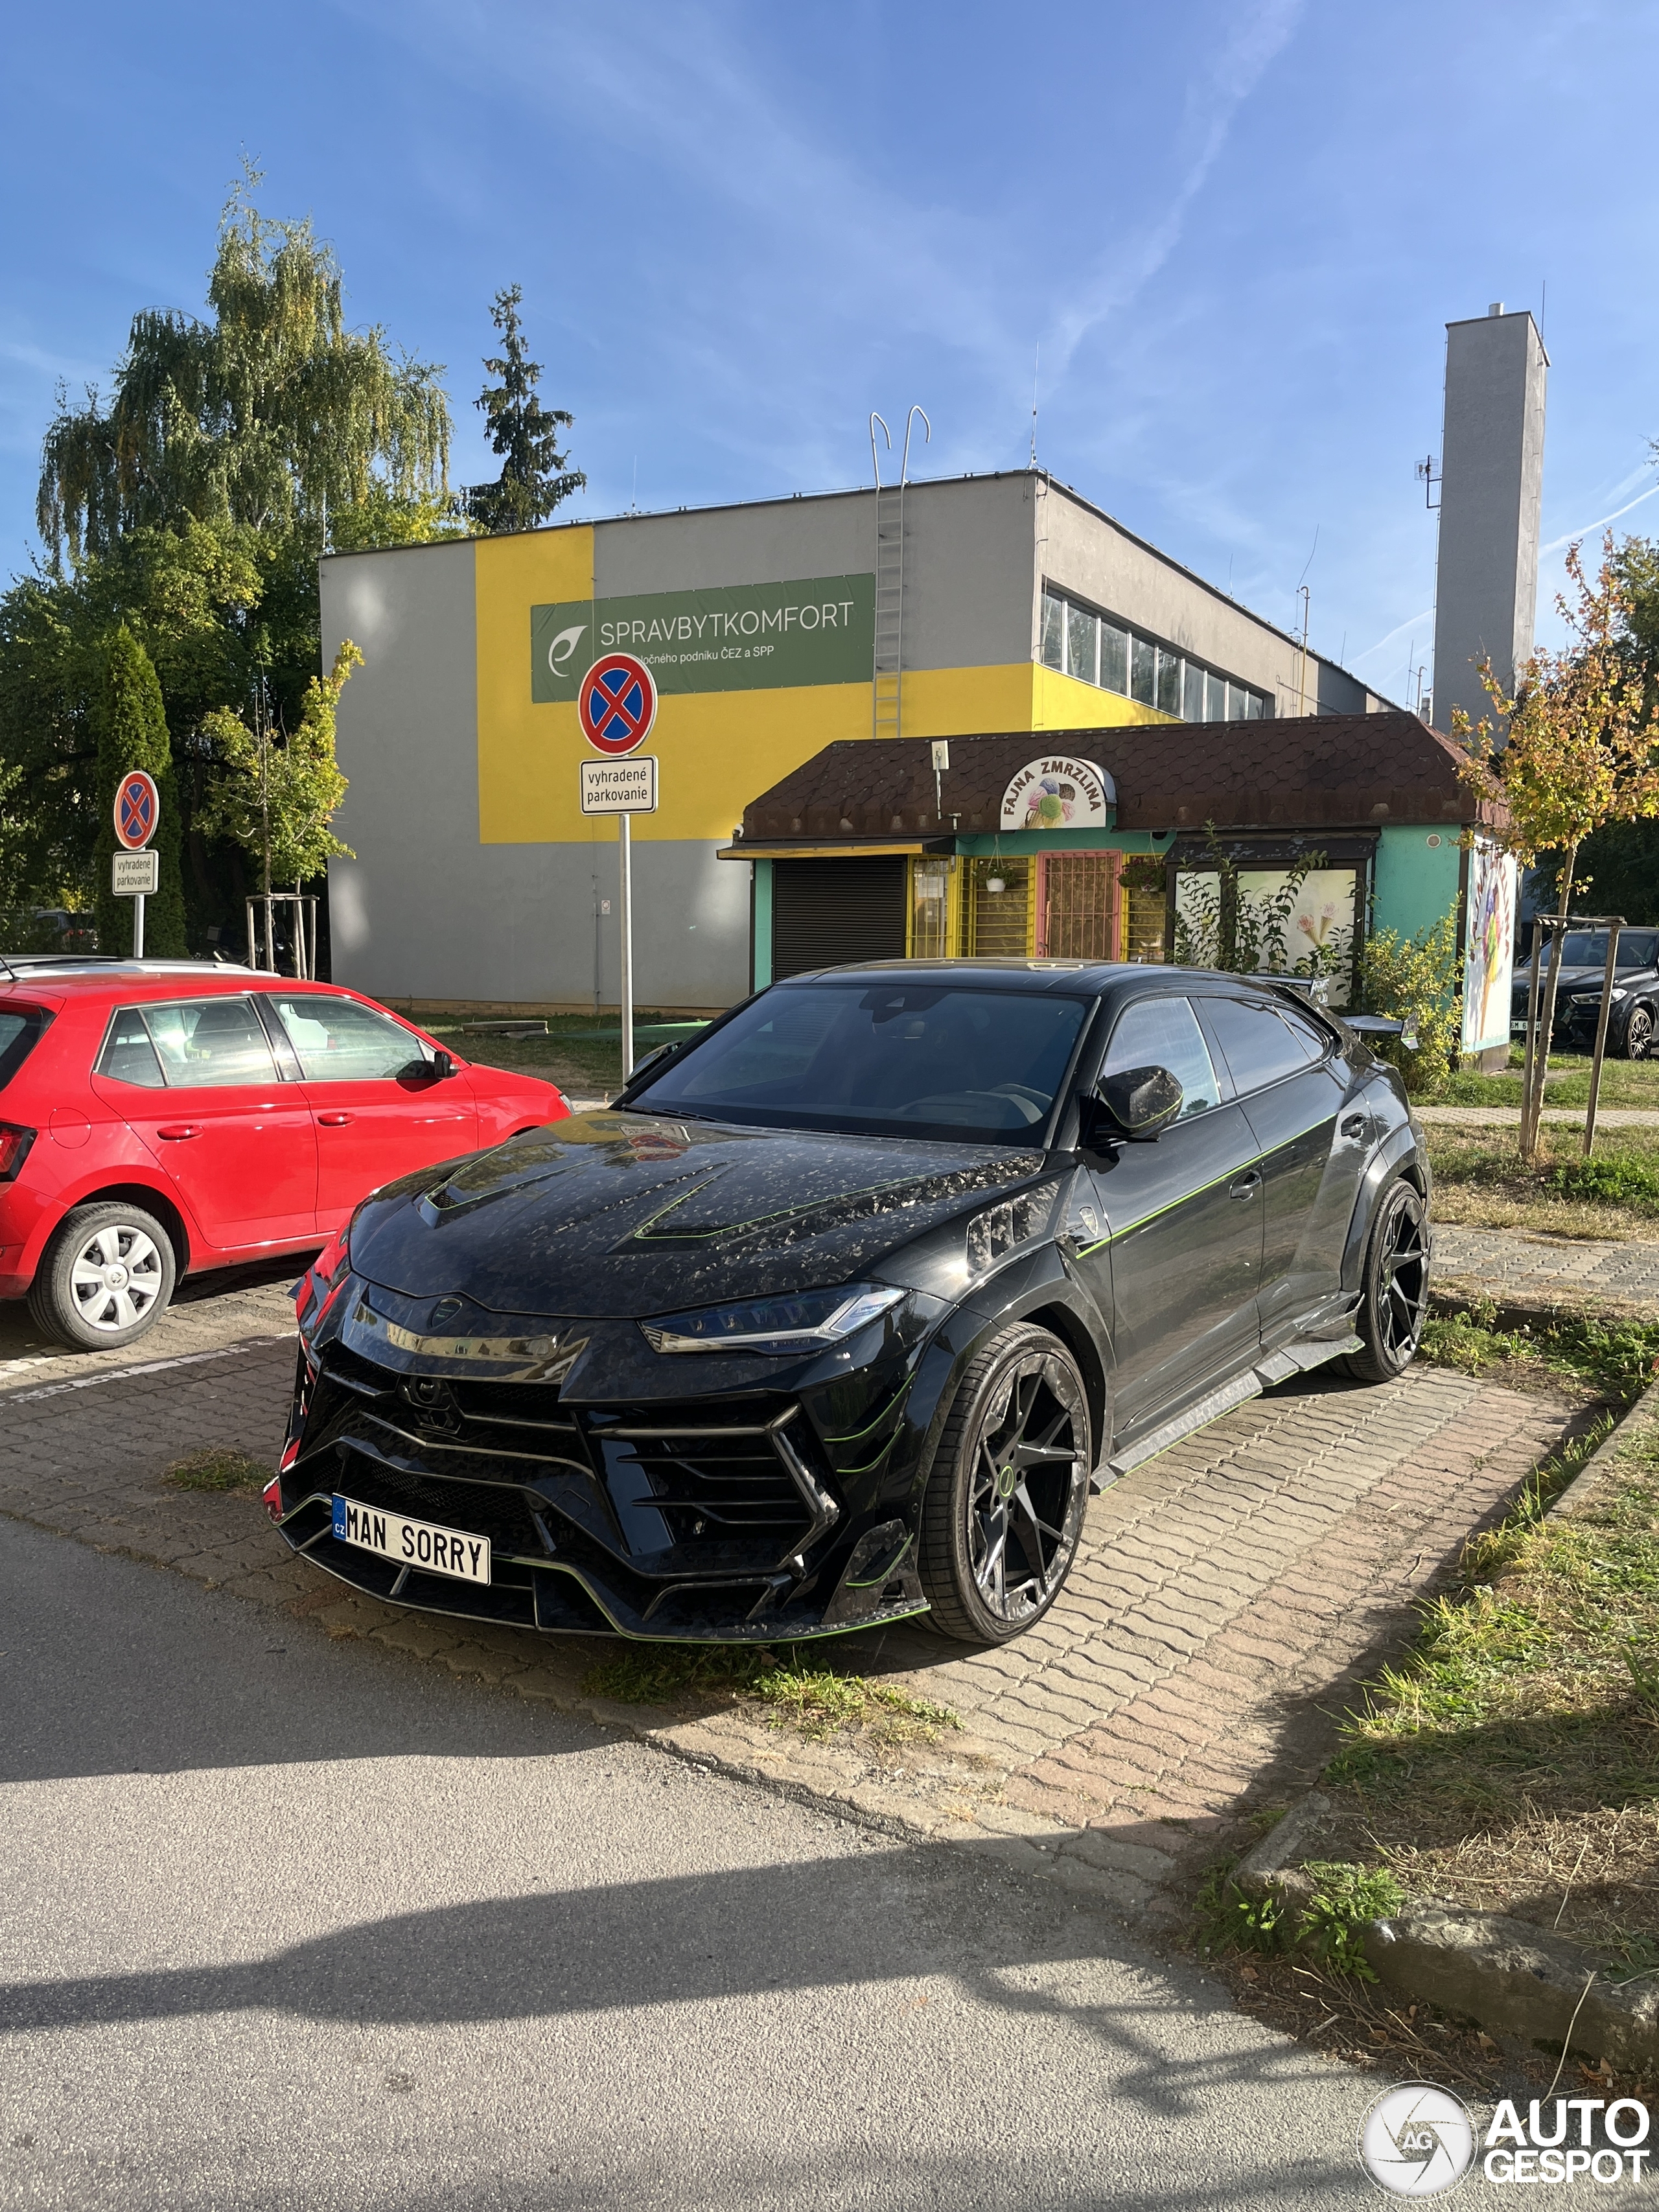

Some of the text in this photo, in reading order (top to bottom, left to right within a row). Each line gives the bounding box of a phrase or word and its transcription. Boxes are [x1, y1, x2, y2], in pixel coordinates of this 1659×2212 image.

[600, 601, 854, 646] SPRAVBYTKOMFORT
[641, 646, 774, 665] ločného podniku ČEZ a SPP
[588, 767, 646, 786] vyhradené
[588, 786, 647, 804] parkovanie
[1004, 760, 1101, 815] FAJNA ZMRZLINA
[117, 857, 150, 873] vyhradené
[117, 874, 150, 888] parkovanie
[335, 1522, 345, 1535] CZ
[957, 1502, 966, 1574] VREDESTEIN
[347, 1505, 481, 1576] MAN SORRY
